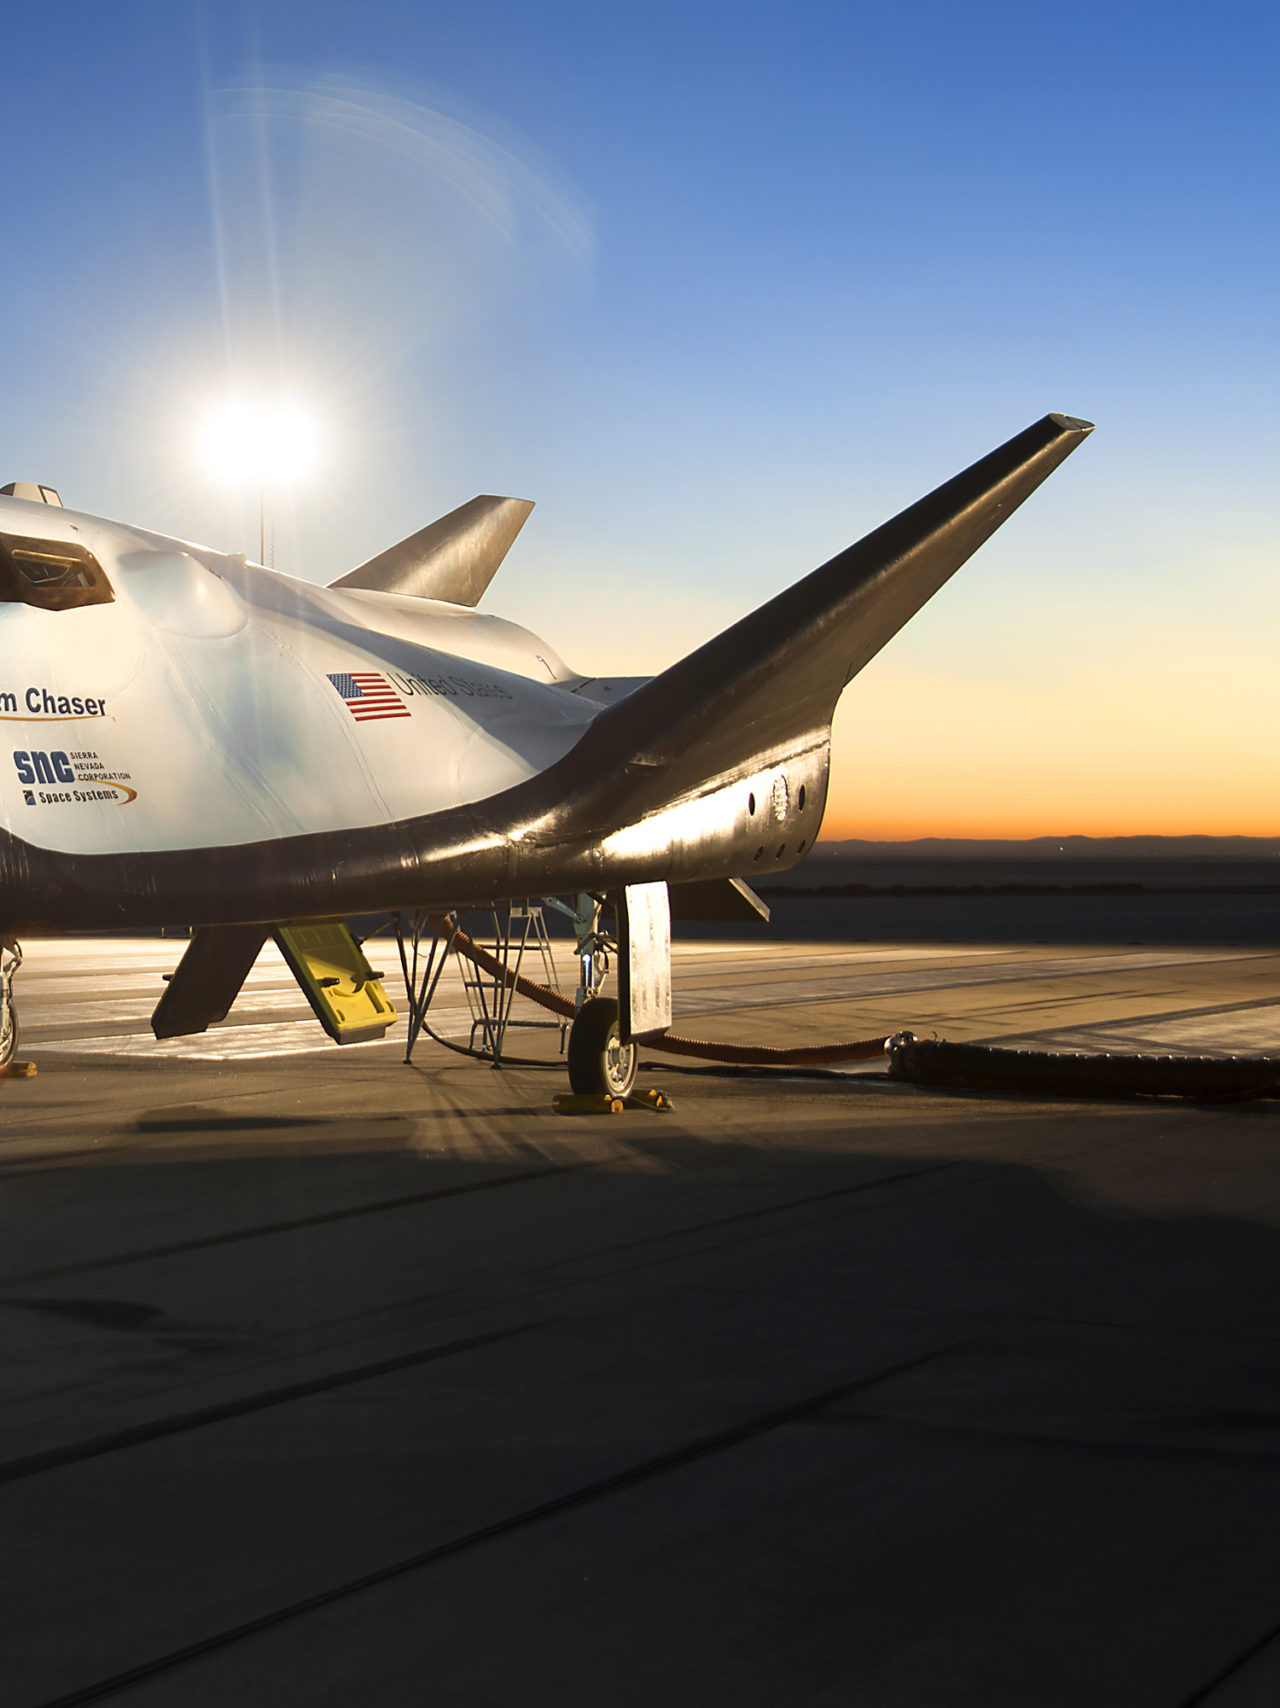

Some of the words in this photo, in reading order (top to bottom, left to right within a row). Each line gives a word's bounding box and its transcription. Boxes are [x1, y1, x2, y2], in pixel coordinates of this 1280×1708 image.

[386, 672, 458, 696] United
[448, 675, 513, 700] States
[25, 687, 106, 716] Chaser
[70, 751, 99, 760] SIERRA
[74, 762, 105, 770] NEVADA
[78, 772, 132, 781] CORPORATION
[38, 791, 72, 804] Space
[73, 789, 119, 802] Systems
